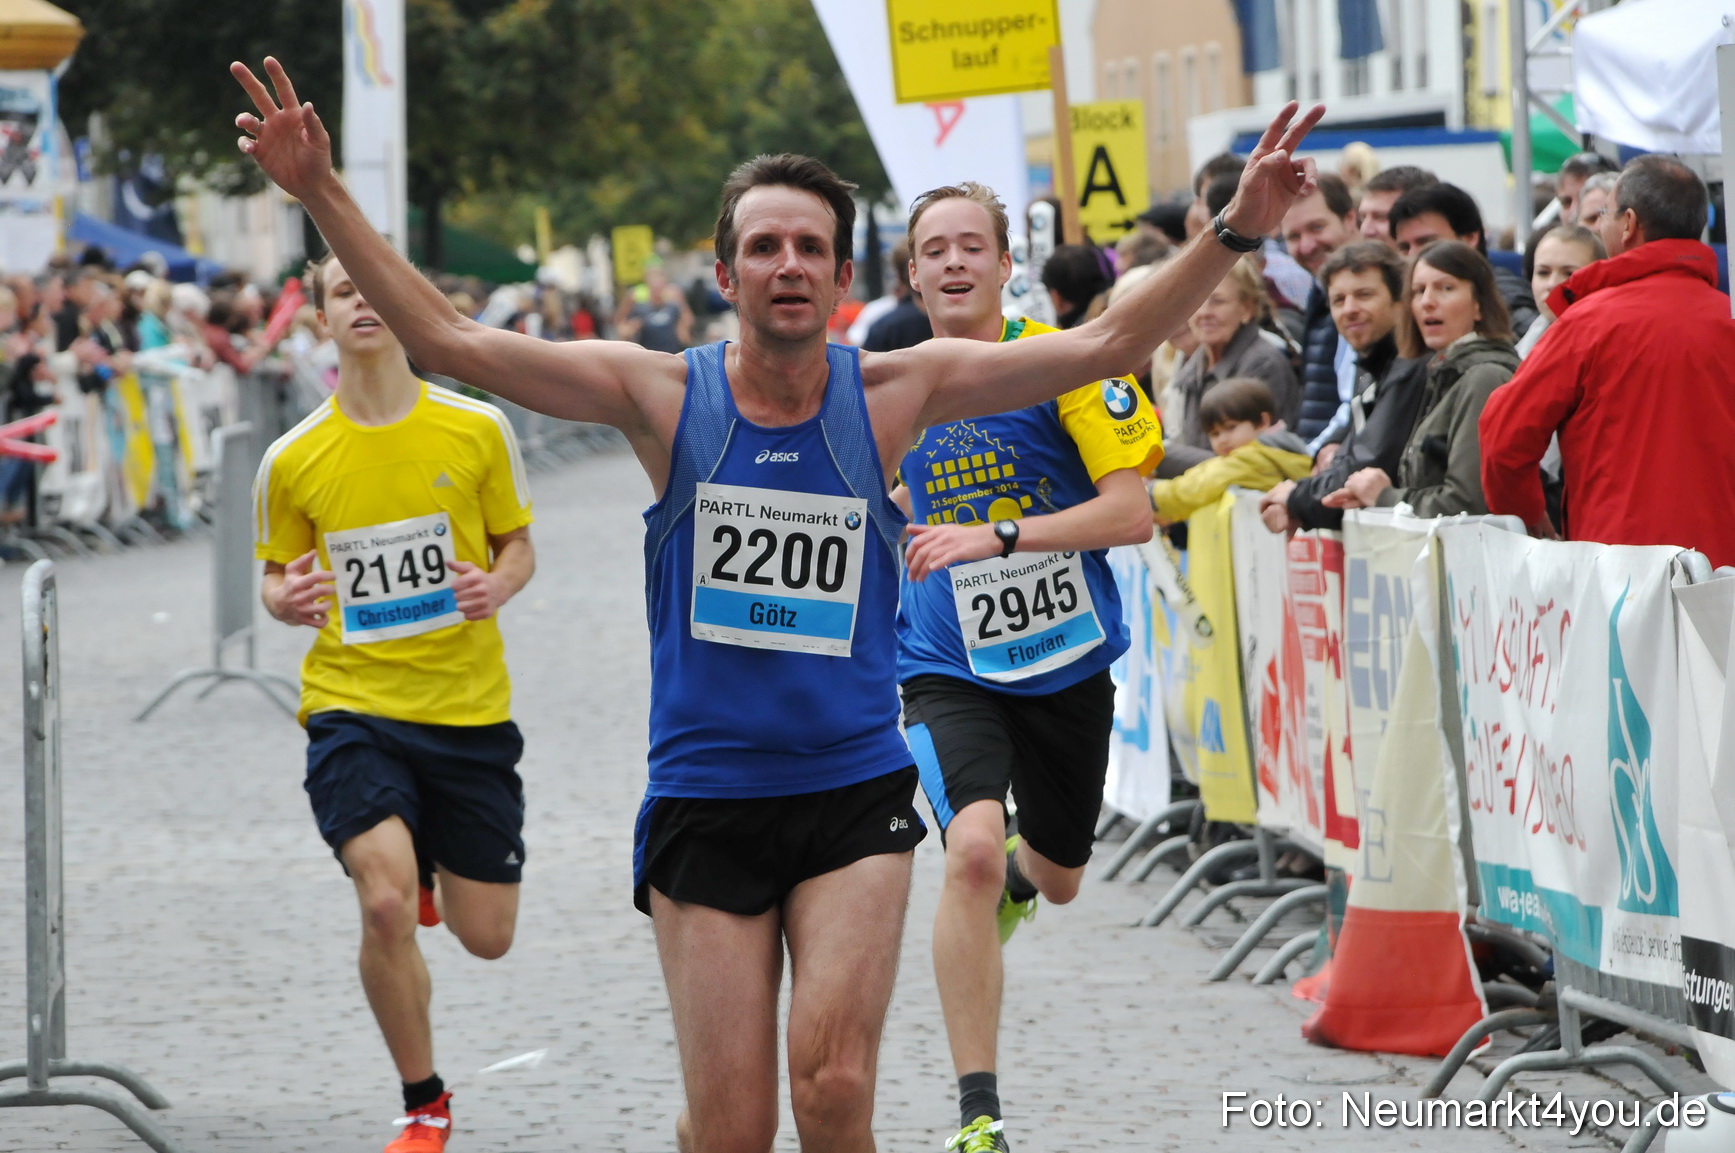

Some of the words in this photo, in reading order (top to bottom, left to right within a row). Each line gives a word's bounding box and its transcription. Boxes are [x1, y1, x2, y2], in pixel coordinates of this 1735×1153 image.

[899, 15, 1047, 43] Schnupper-
[951, 46, 999, 70] lauf
[1080, 145, 1126, 207] A
[1113, 417, 1152, 437] PARTL
[1119, 424, 1156, 445] Neumarkt
[769, 451, 799, 463] asics
[996, 481, 1019, 496] 2014
[699, 499, 755, 518] PARTL
[759, 505, 838, 526] Neumarkt
[329, 541, 368, 554] PARTL
[371, 529, 430, 547] Neumarkt
[345, 544, 446, 598] 2149
[711, 524, 848, 593] 2200
[955, 573, 998, 591] PARTL
[1000, 552, 1060, 581] Neumarkt
[357, 599, 446, 626] Christopher
[750, 602, 798, 628] Götz
[971, 566, 1078, 640] 2945
[1007, 634, 1066, 665] Florian
